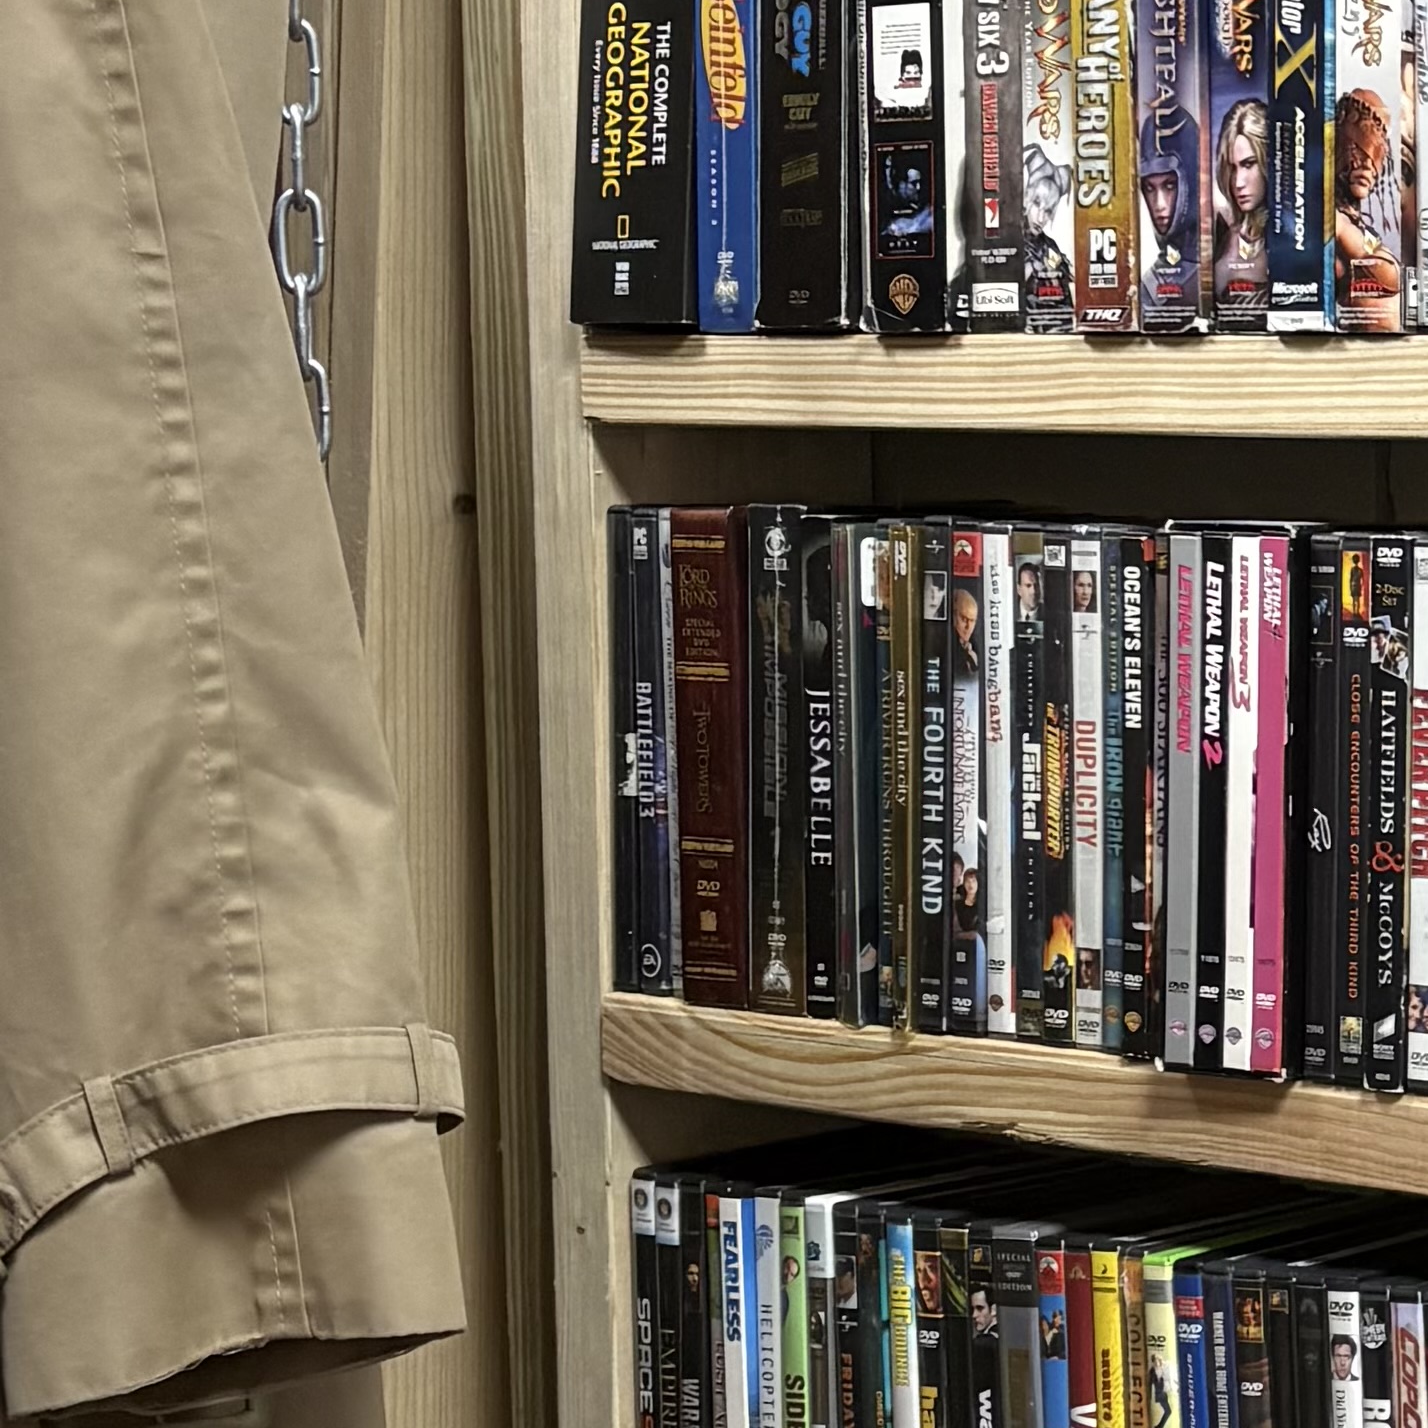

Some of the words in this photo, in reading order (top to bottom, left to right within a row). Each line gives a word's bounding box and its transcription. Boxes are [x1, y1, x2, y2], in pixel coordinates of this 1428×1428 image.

[626, 22, 647, 174] NATIONAL
[655, 22, 671, 54] THE
[602, 3, 626, 198] GEOGRAPHIC
[651, 56, 669, 165] COMPLETE
[1076, 58, 1116, 206] HEROES
[926, 657, 940, 696] THE
[809, 688, 832, 866] JESSABELLE
[924, 706, 945, 825] FOURTH
[1075, 720, 1098, 848] DUPLICITY
[922, 837, 943, 915] KIND
[723, 1220, 741, 1342] FEARLESS
